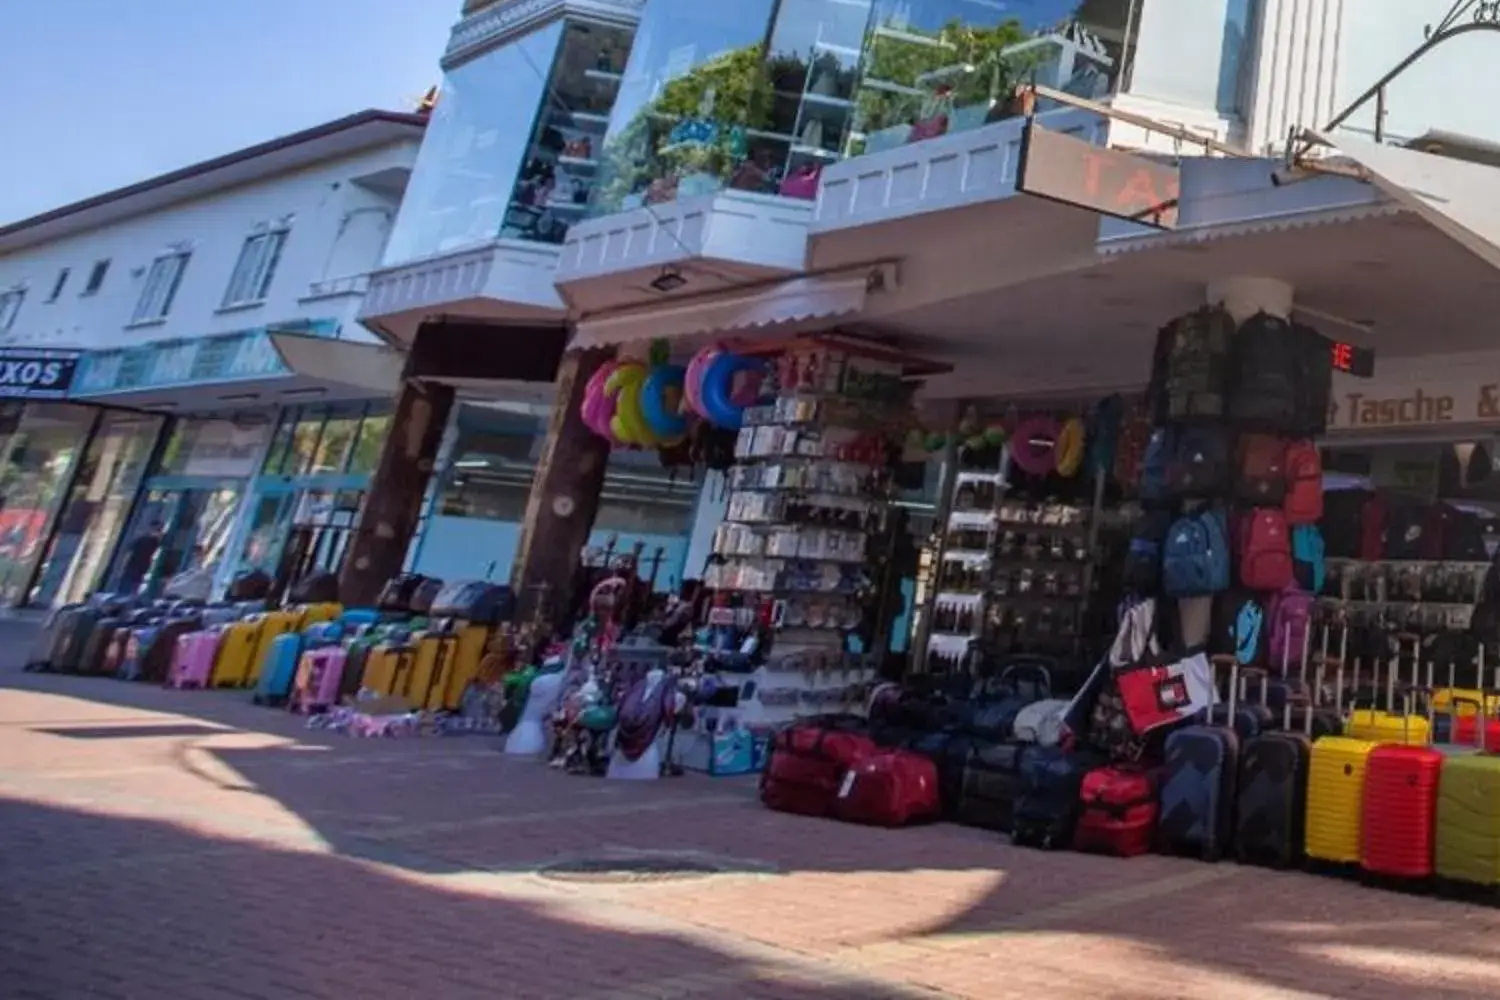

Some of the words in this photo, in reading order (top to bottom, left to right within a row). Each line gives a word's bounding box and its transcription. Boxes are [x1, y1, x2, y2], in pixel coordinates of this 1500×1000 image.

[0, 361, 62, 385] XOS
[1346, 388, 1454, 424] Tasche
[1477, 384, 1500, 419] &
